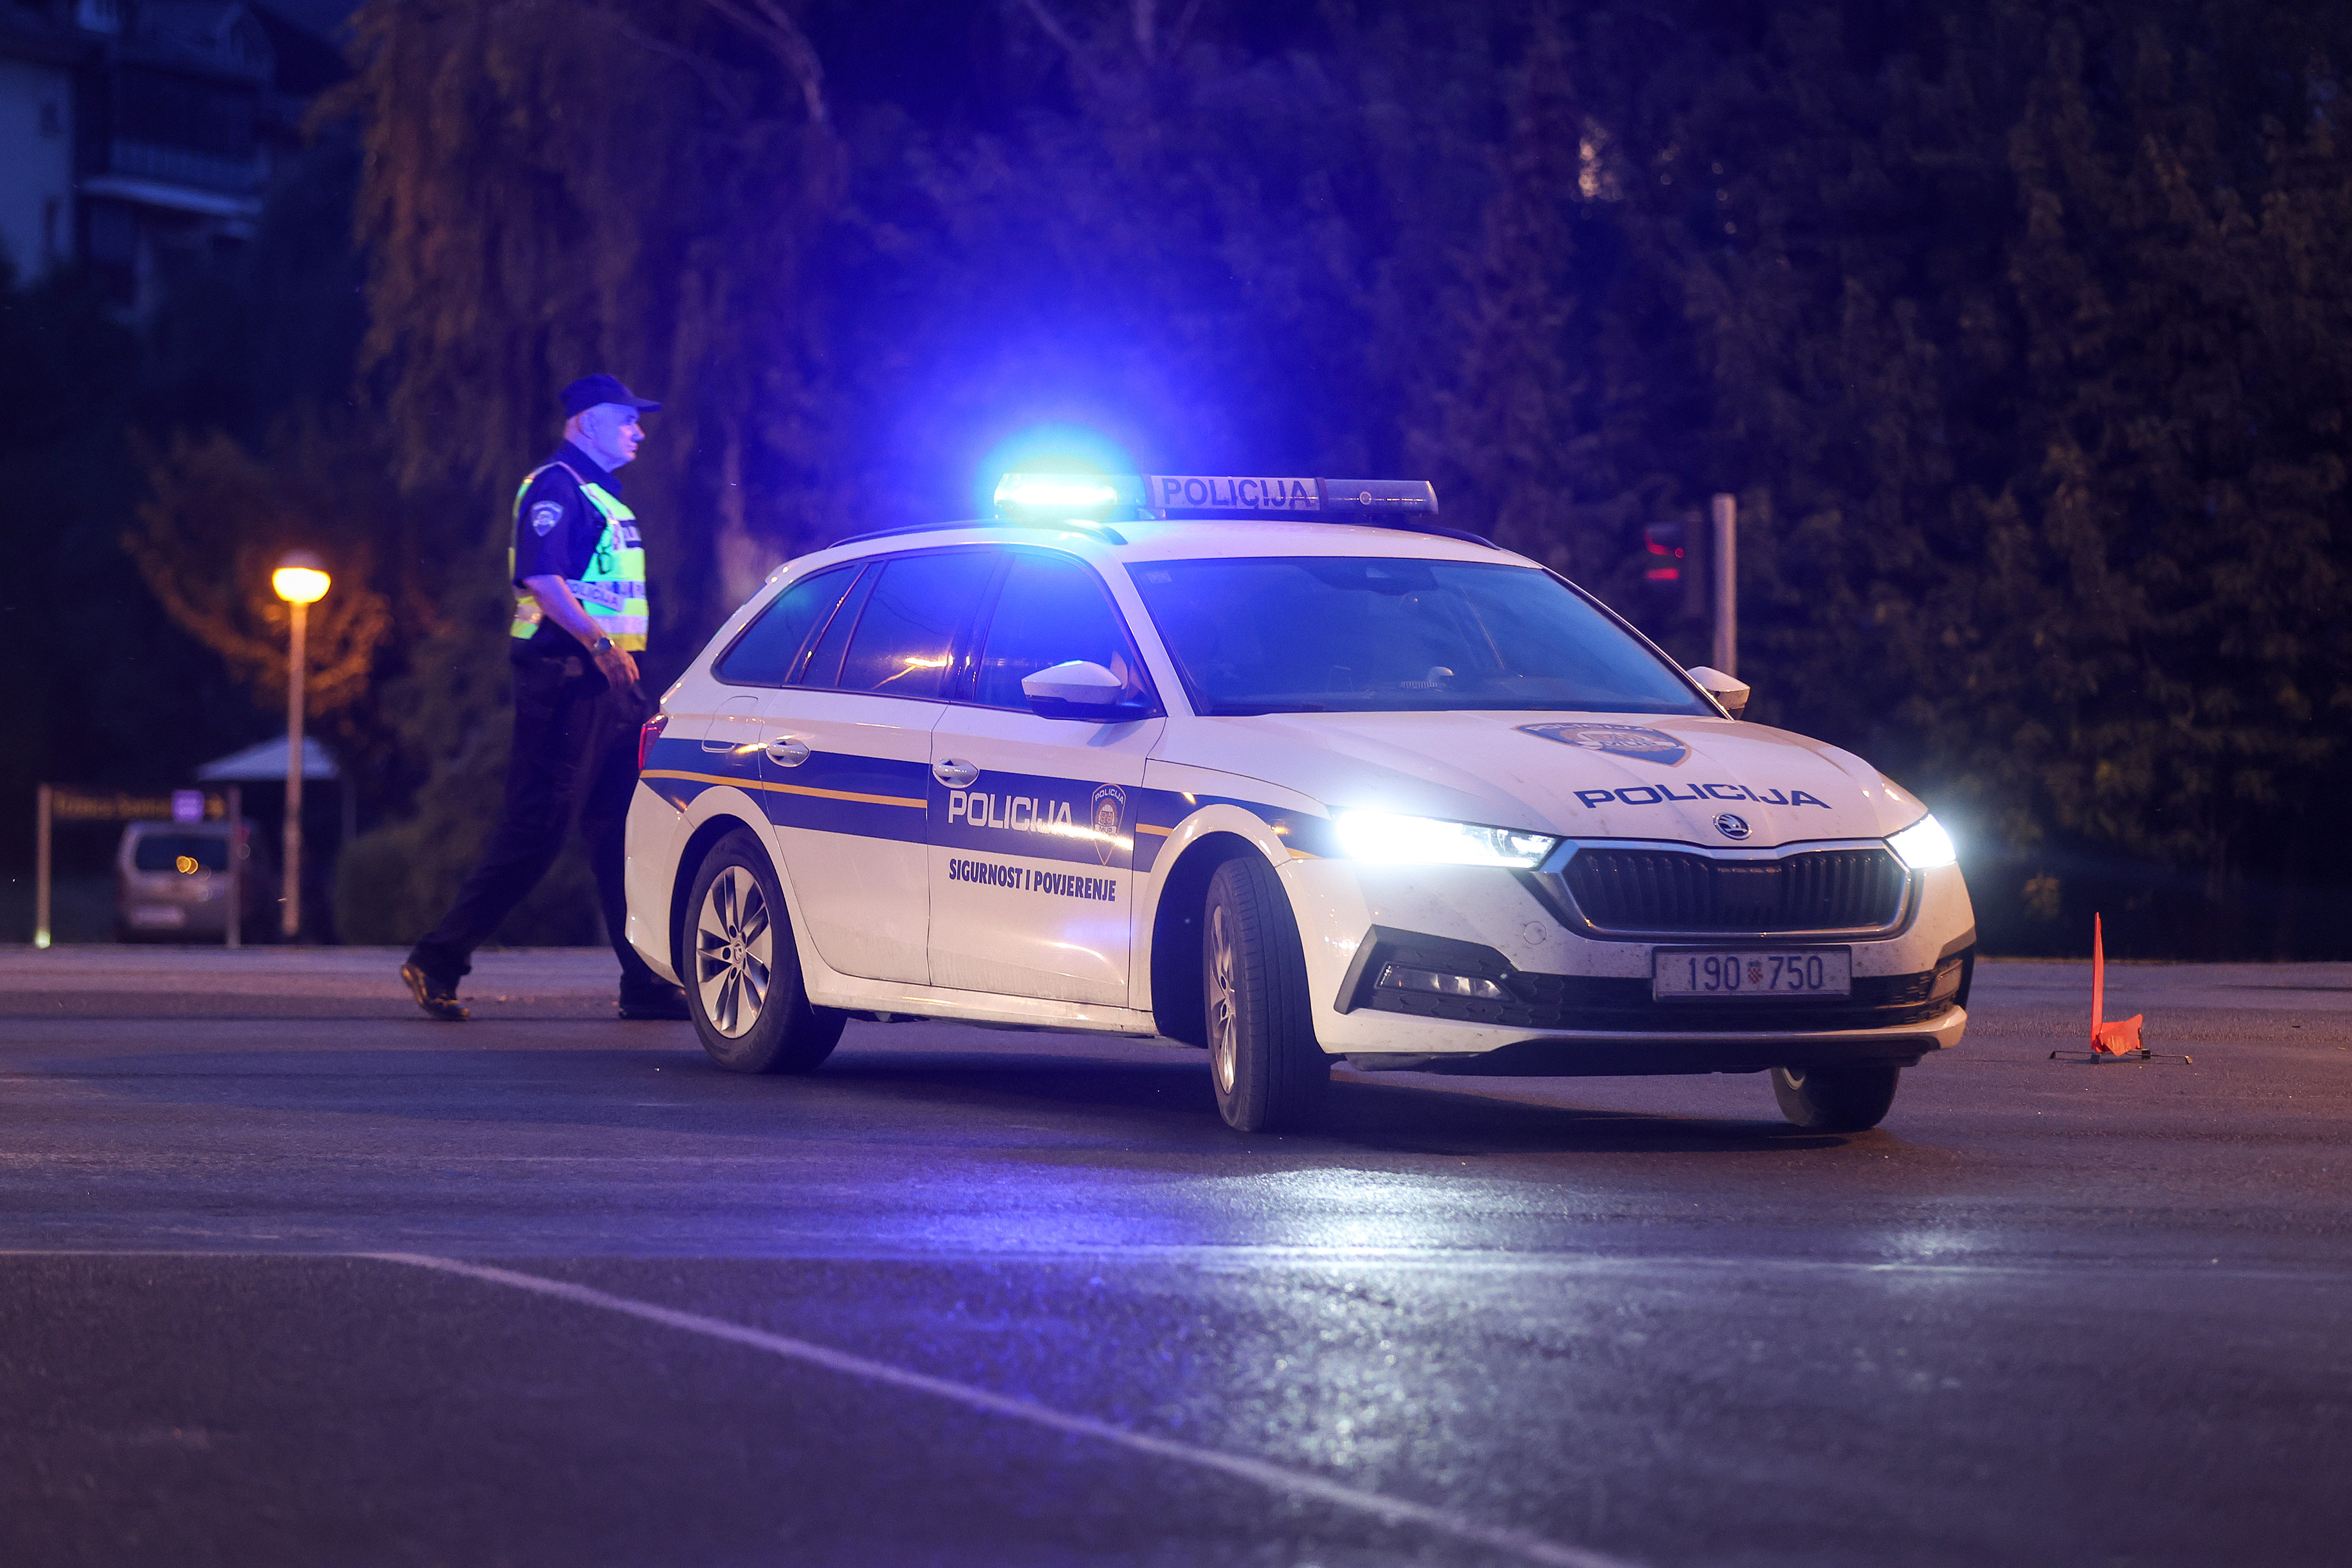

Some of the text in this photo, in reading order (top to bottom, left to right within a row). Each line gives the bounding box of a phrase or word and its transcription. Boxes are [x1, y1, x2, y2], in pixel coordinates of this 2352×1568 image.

[1162, 478, 1312, 507] POLICIJA
[948, 790, 1073, 834] POLICIJA
[1095, 788, 1124, 805] POLICIJA
[1573, 783, 1833, 810] POLICIJA
[949, 858, 1117, 901] SIGURNOST I POVJERENJE
[1689, 955, 1823, 990] 190 750
